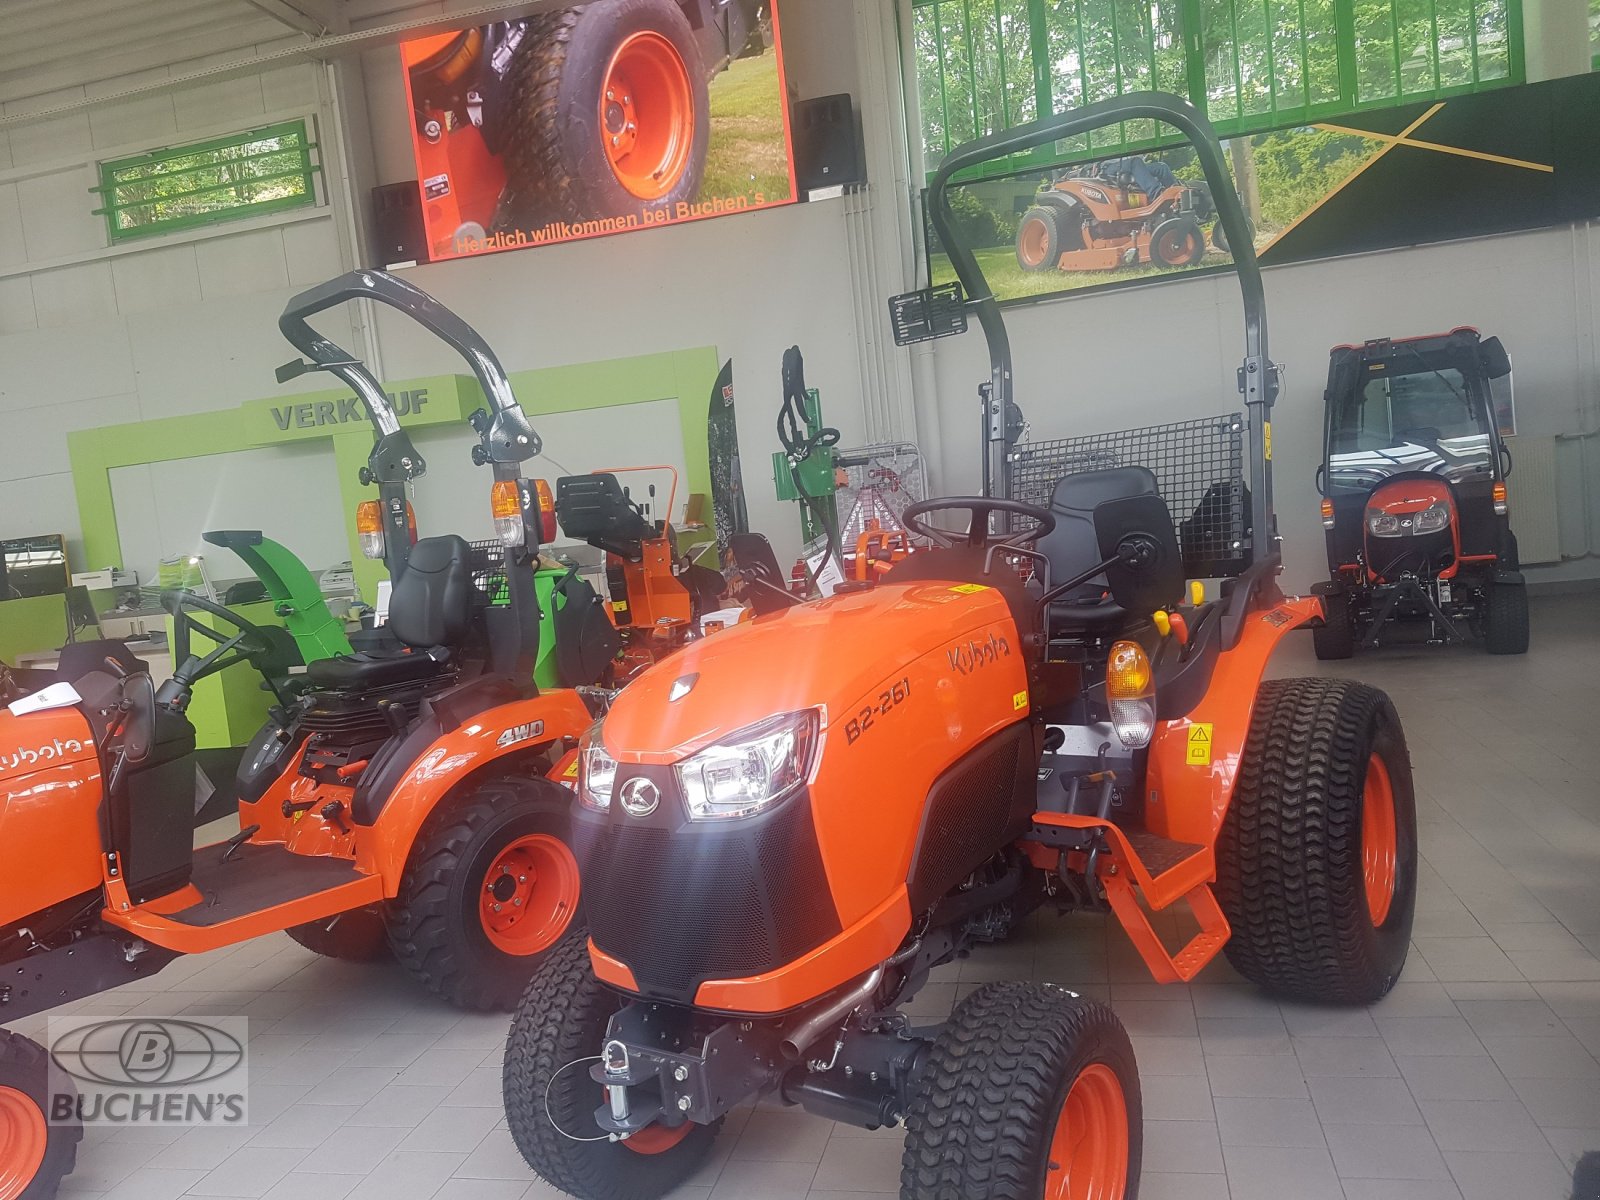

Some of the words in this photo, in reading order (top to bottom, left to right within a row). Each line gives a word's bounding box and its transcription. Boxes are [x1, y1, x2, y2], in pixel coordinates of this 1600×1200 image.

[456, 228, 527, 254] Herzlich
[531, 214, 638, 243] willkommen
[642, 205, 671, 225] bei
[270, 389, 428, 430] VERKUF
[946, 633, 1011, 676] Kubota
[844, 677, 911, 746] B2-261
[496, 719, 545, 748] 4WD
